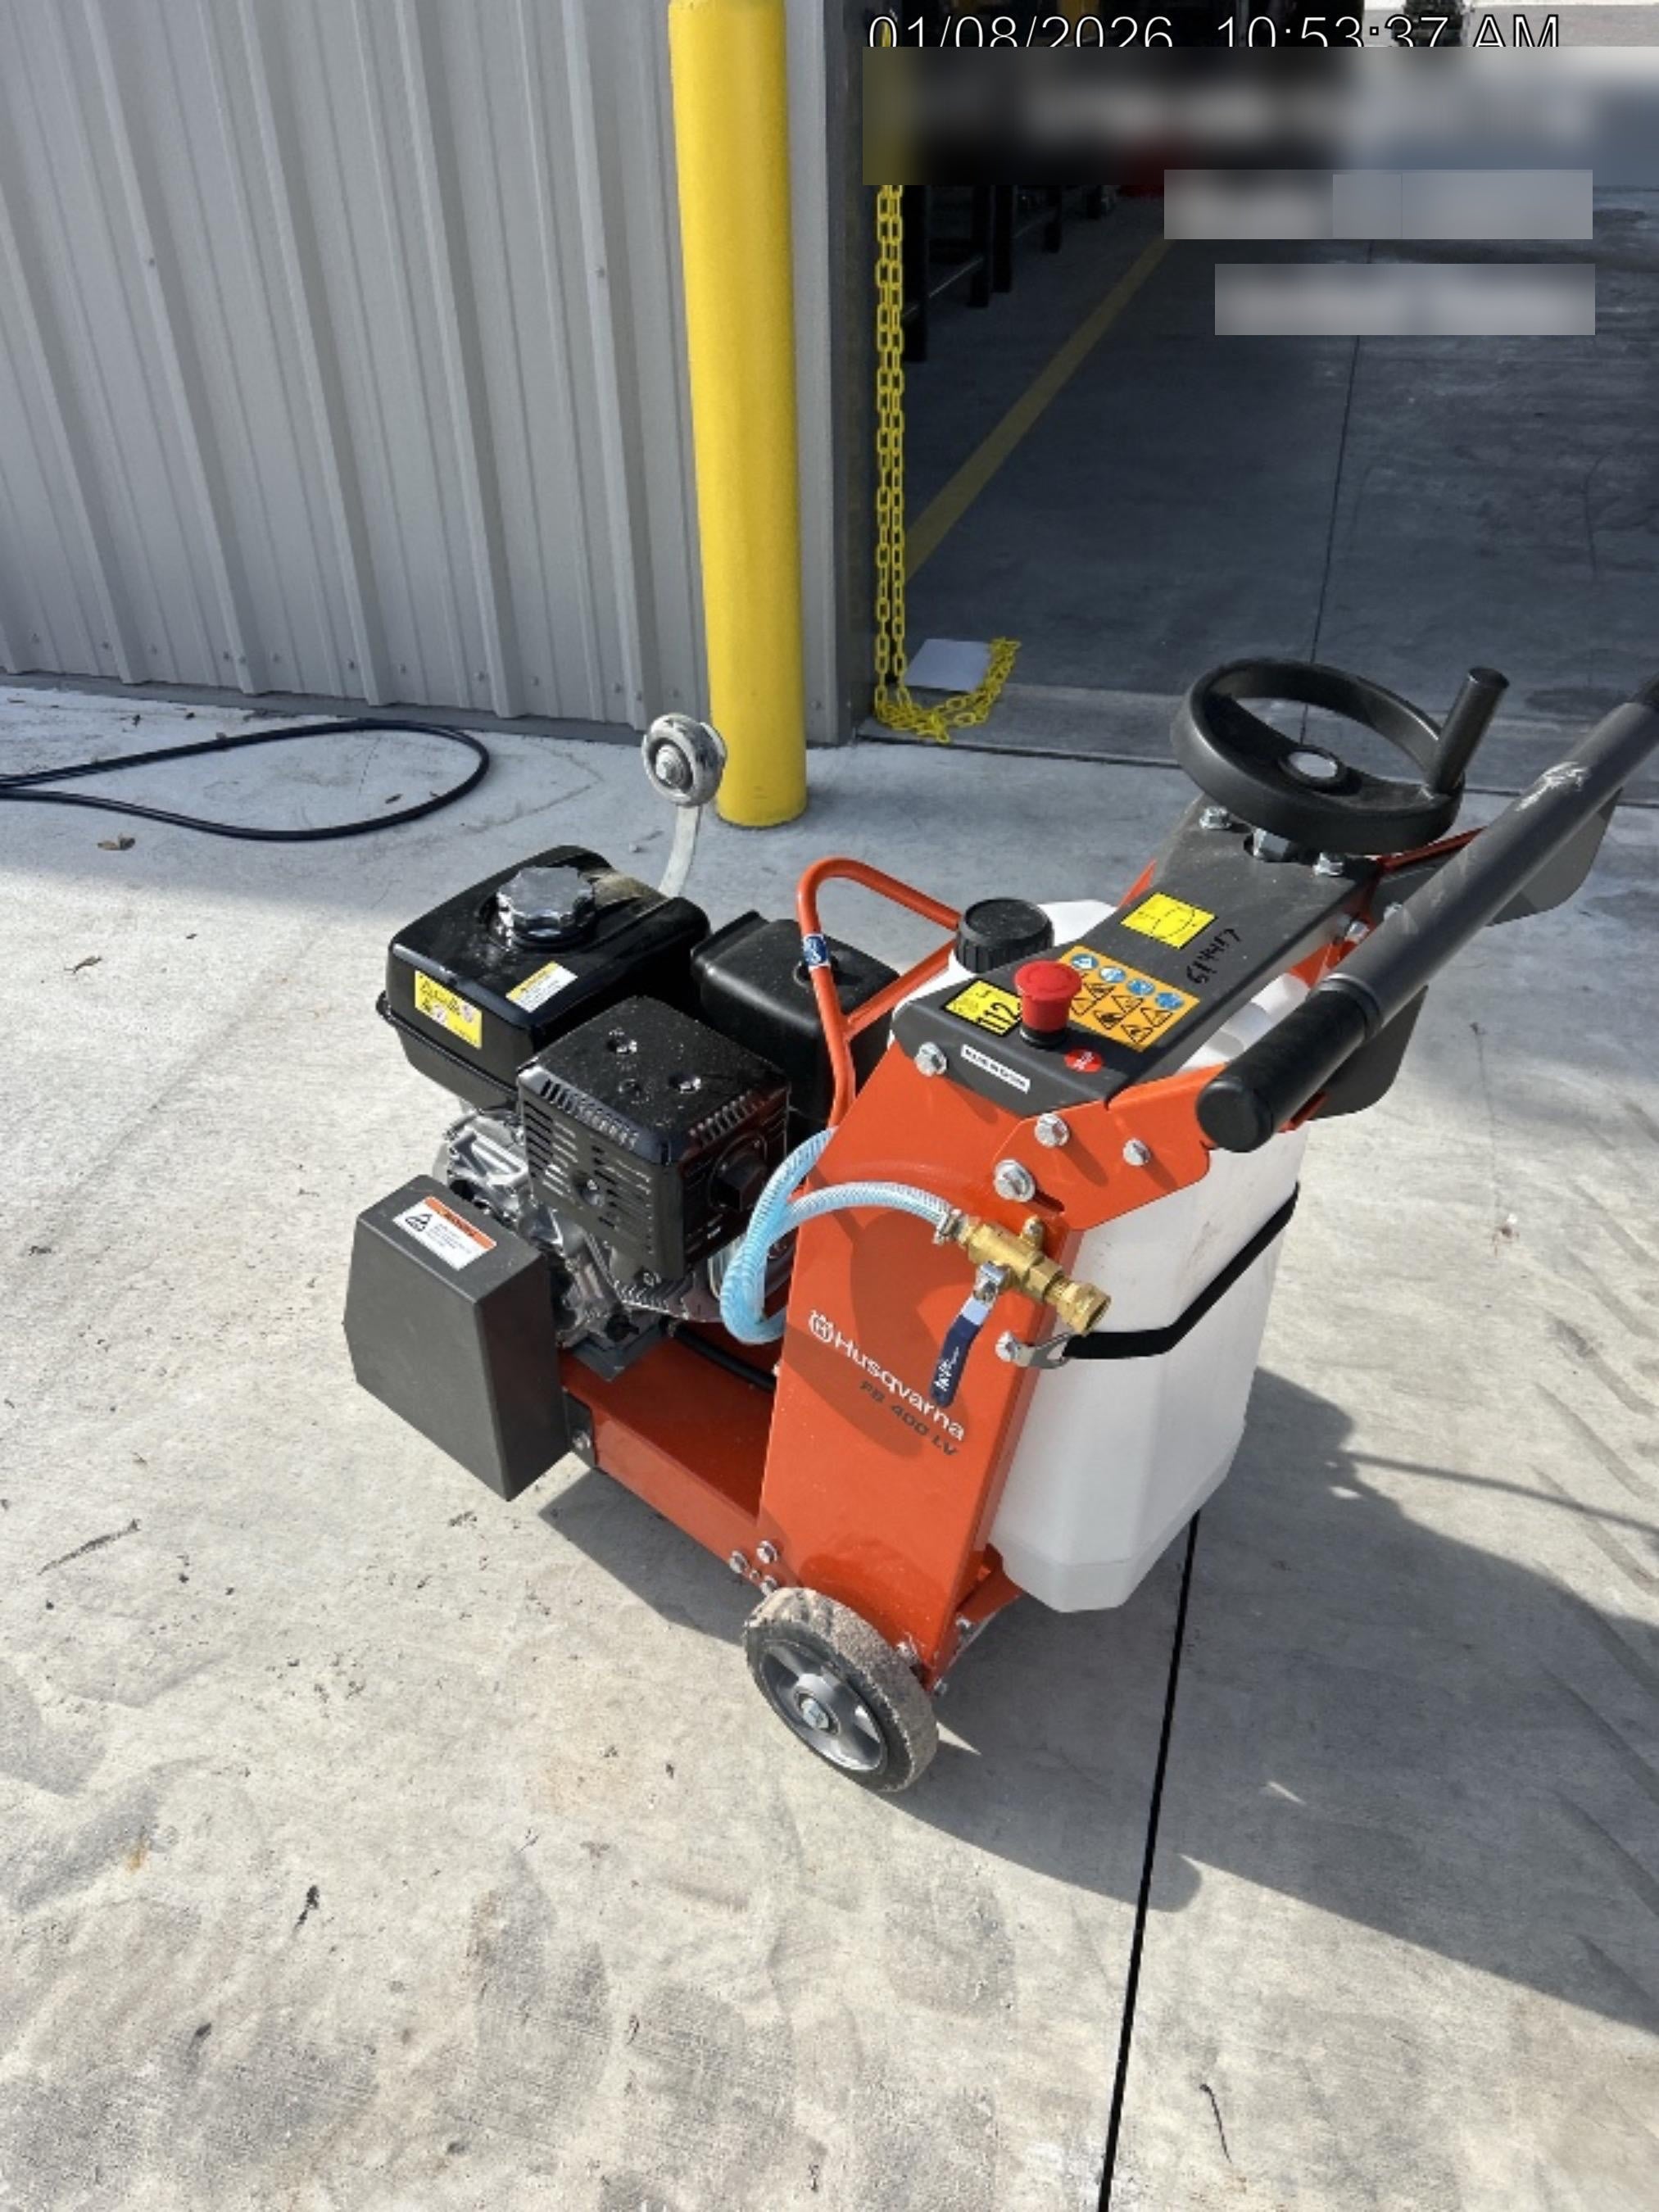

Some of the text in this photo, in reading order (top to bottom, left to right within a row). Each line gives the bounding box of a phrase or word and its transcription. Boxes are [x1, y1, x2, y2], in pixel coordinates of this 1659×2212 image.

[835, 1331, 965, 1442] Husqvarna
[891, 1403, 930, 1435] 400
[931, 1434, 959, 1456] LV
